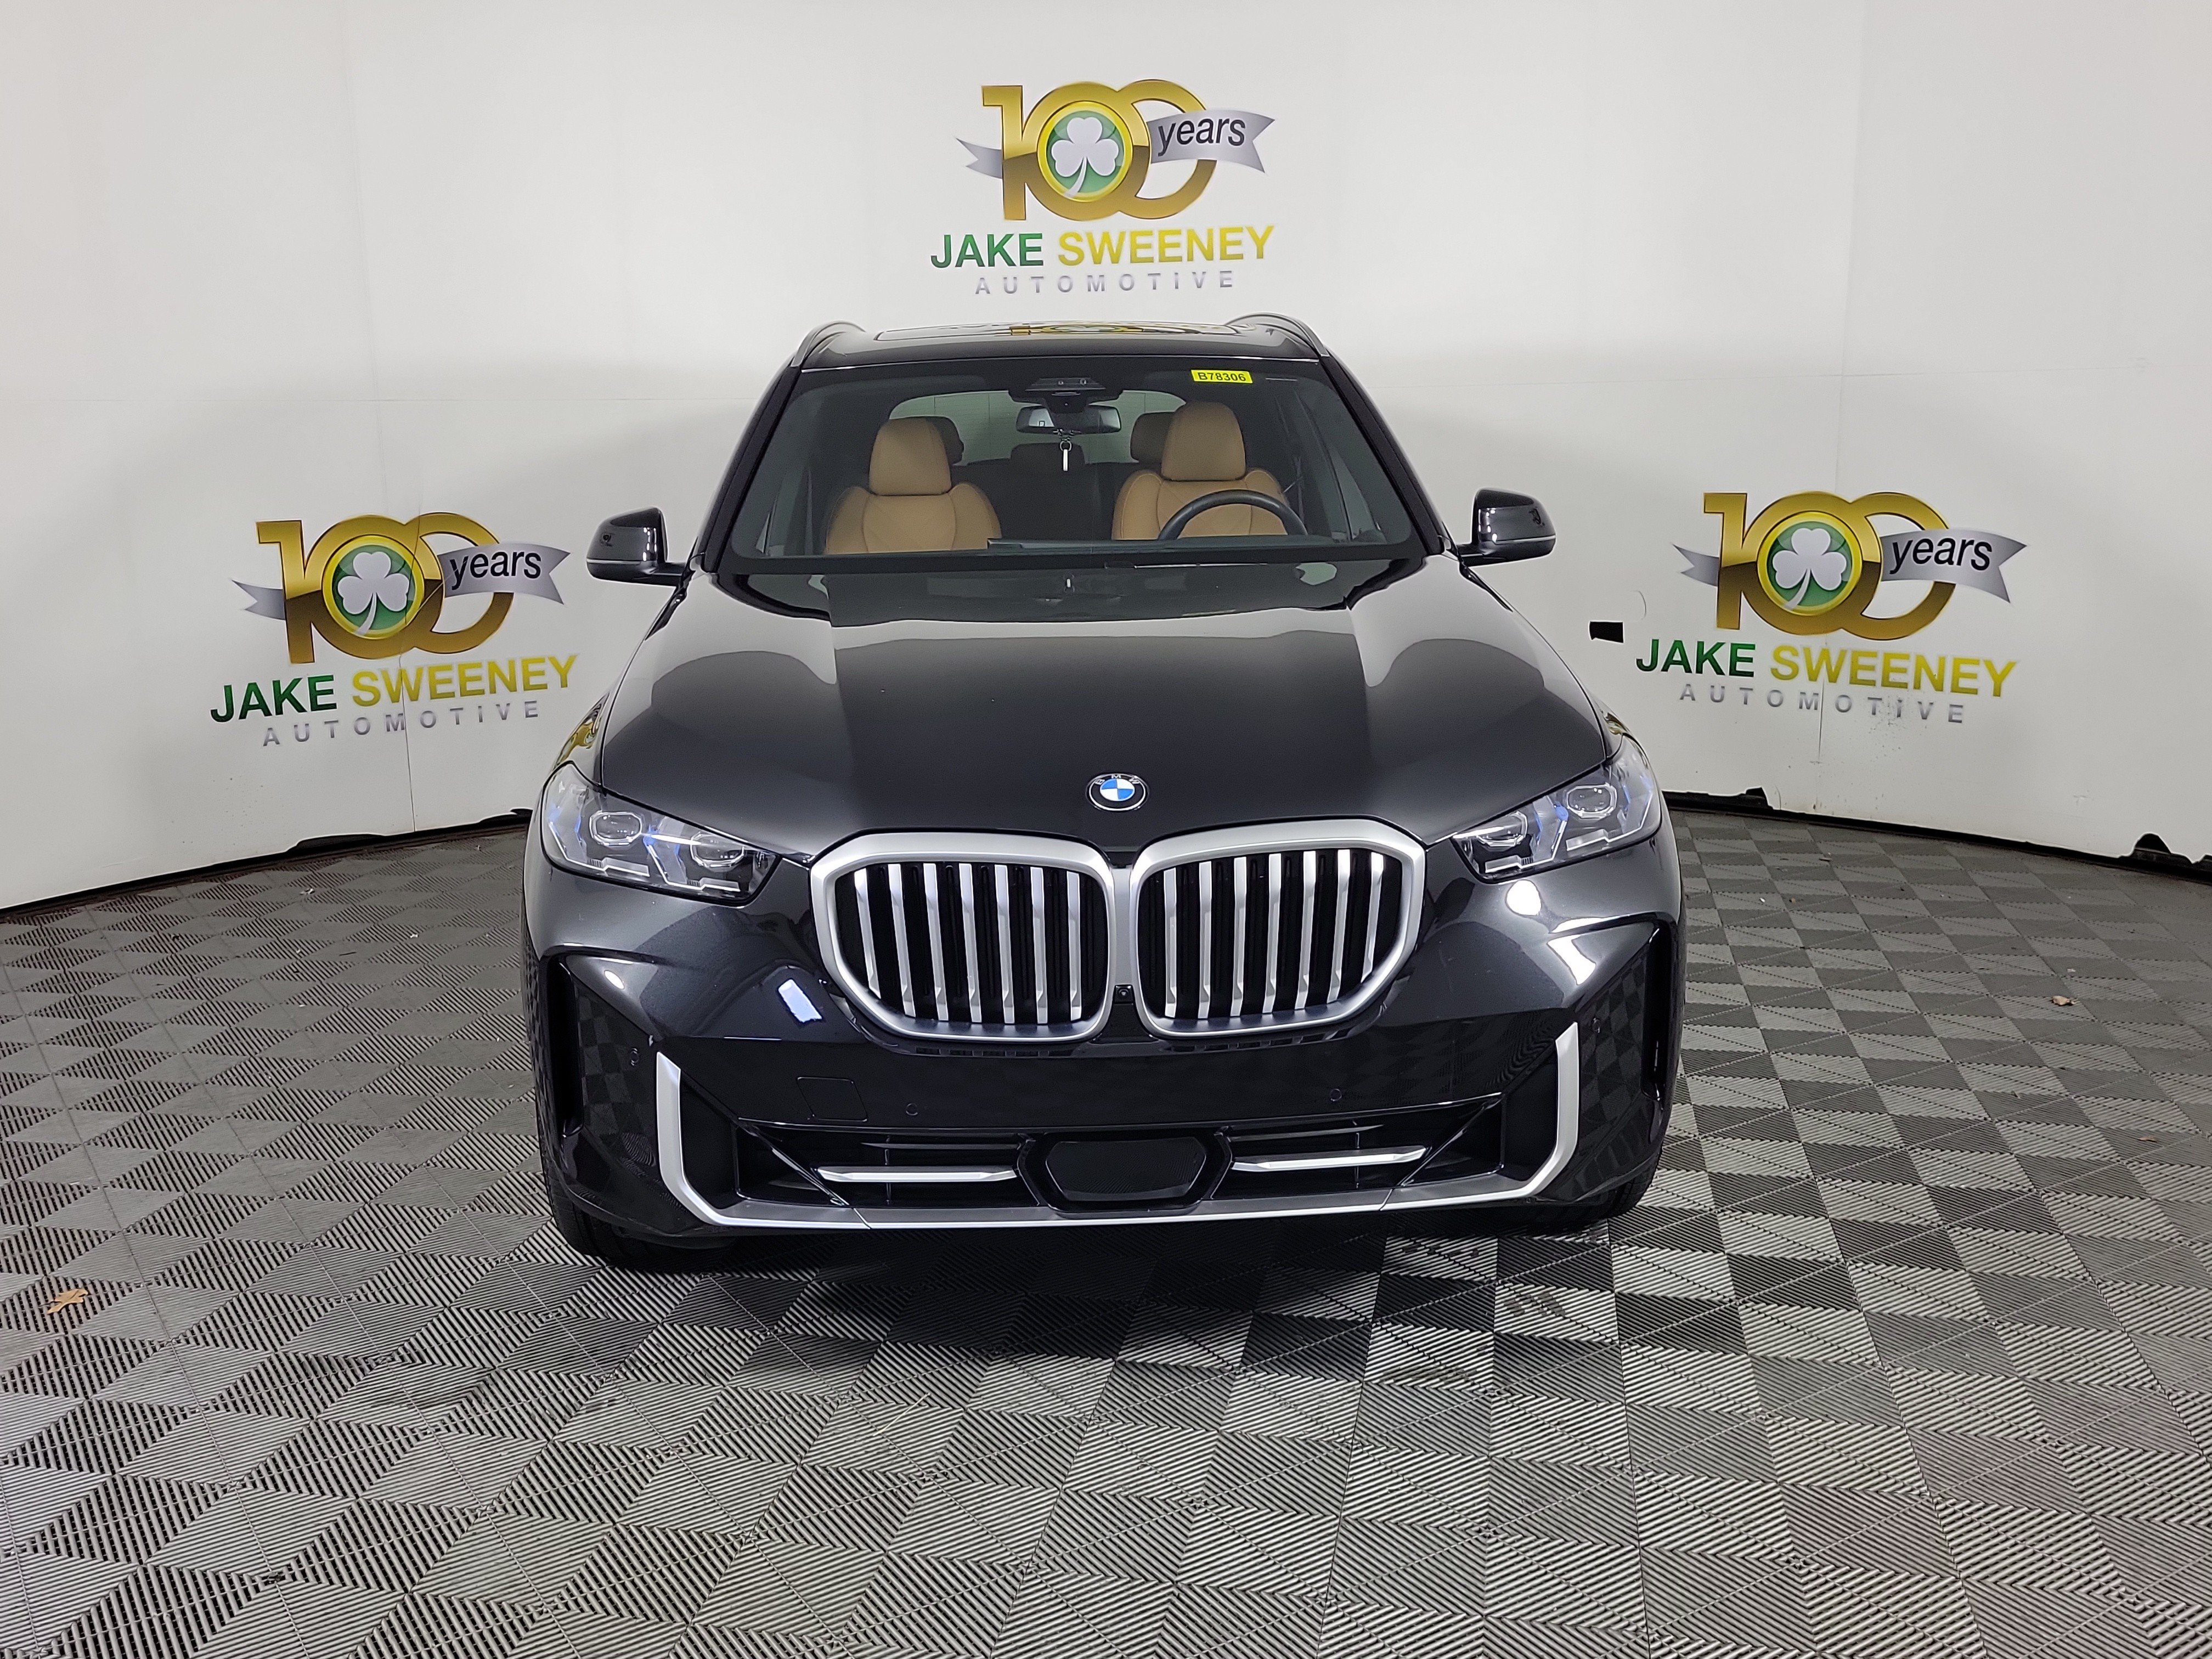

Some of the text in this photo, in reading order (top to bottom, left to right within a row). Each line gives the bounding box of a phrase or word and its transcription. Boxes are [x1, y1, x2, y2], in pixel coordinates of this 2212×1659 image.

[981, 79, 1246, 221] 100 years
[930, 225, 1274, 268] JAKE SWEENEY
[975, 270, 1233, 295] AUTOMOTIVE
[1197, 372, 1246, 382] B78306
[256, 511, 541, 663] 100 years
[1703, 490, 1993, 641] 100 years
[210, 654, 578, 723] JAKE SWEENEY
[1635, 639, 2017, 698] JAKE SWEENEY
[262, 700, 539, 747] AUTOMOTIVE
[1679, 683, 1963, 724] AUTOMOTIVE
